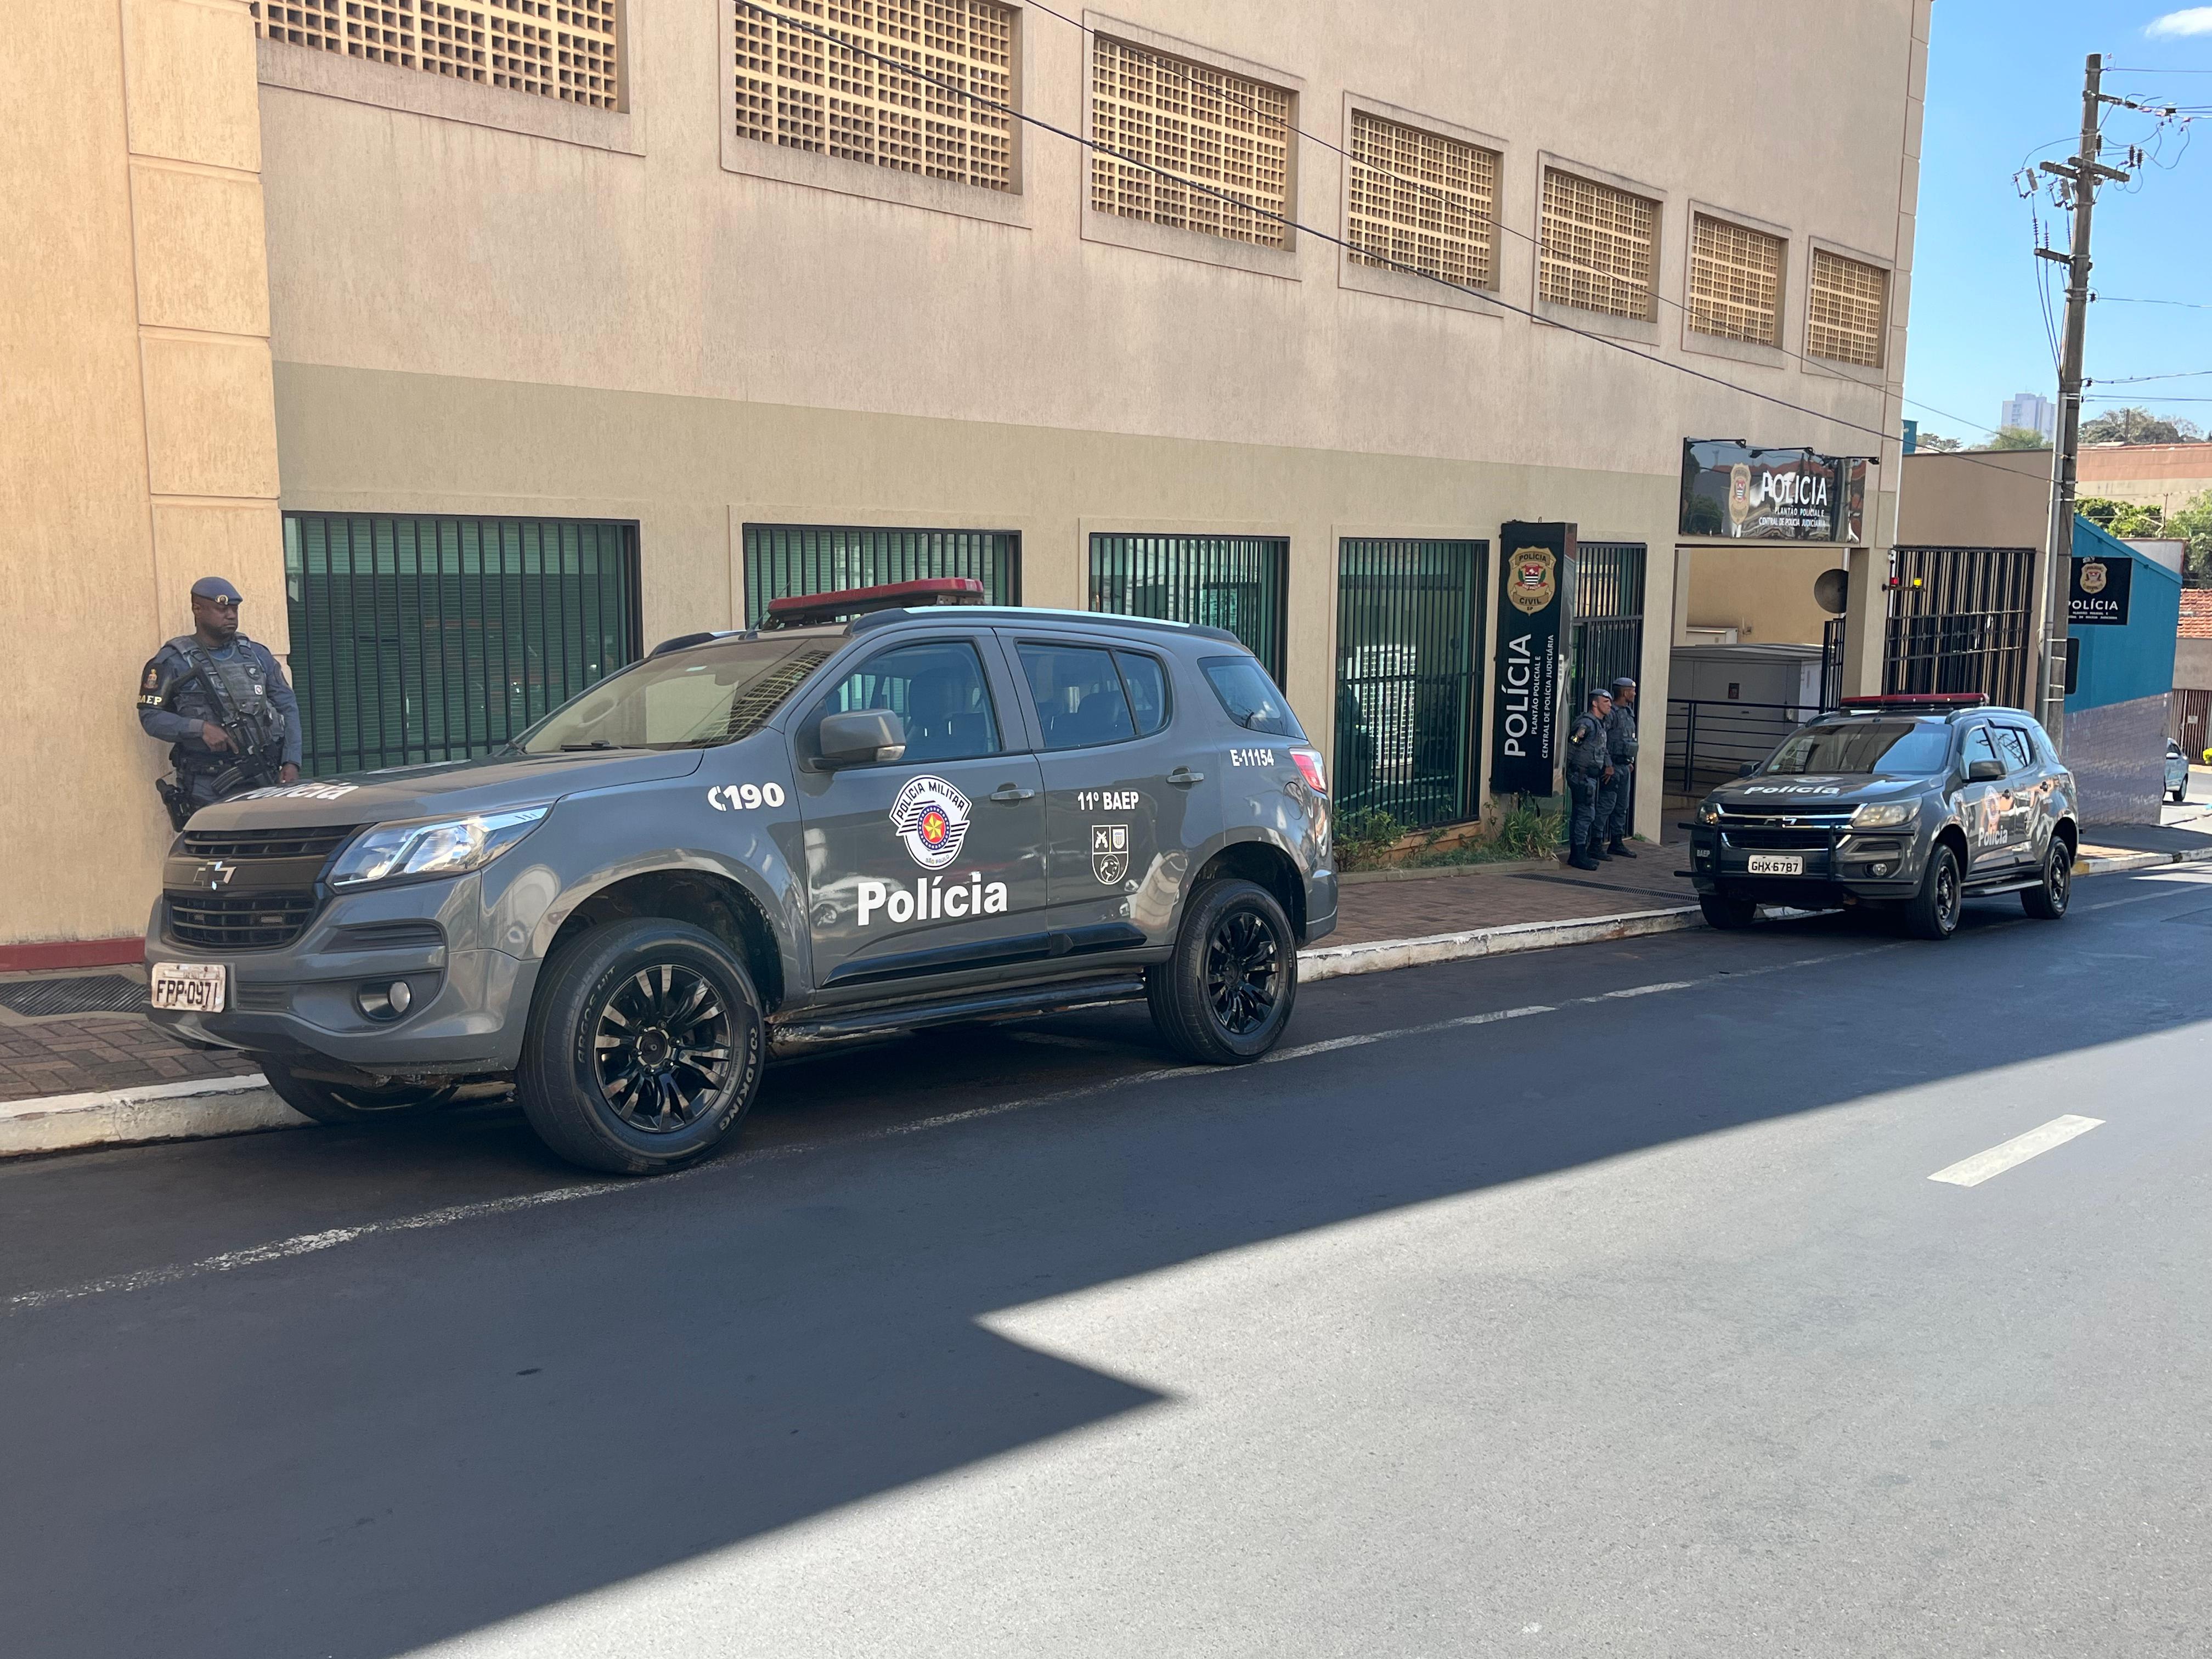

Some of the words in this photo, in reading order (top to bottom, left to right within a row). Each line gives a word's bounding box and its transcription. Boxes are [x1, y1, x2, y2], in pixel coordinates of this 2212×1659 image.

[1519, 552, 1547, 562] POLÍCIA
[1545, 635, 1554, 679] JUDICIÁRIA
[1501, 634, 1531, 757] POLÍCIA
[1544, 680, 1552, 710] POLÍCIA
[1544, 712, 1550, 723] DE
[1229, 749, 1274, 766] E-11154
[725, 782, 785, 810] 190
[929, 781, 964, 811] MILITAR
[1103, 792, 1139, 810] BAEP
[857, 871, 1008, 926] Polícia
